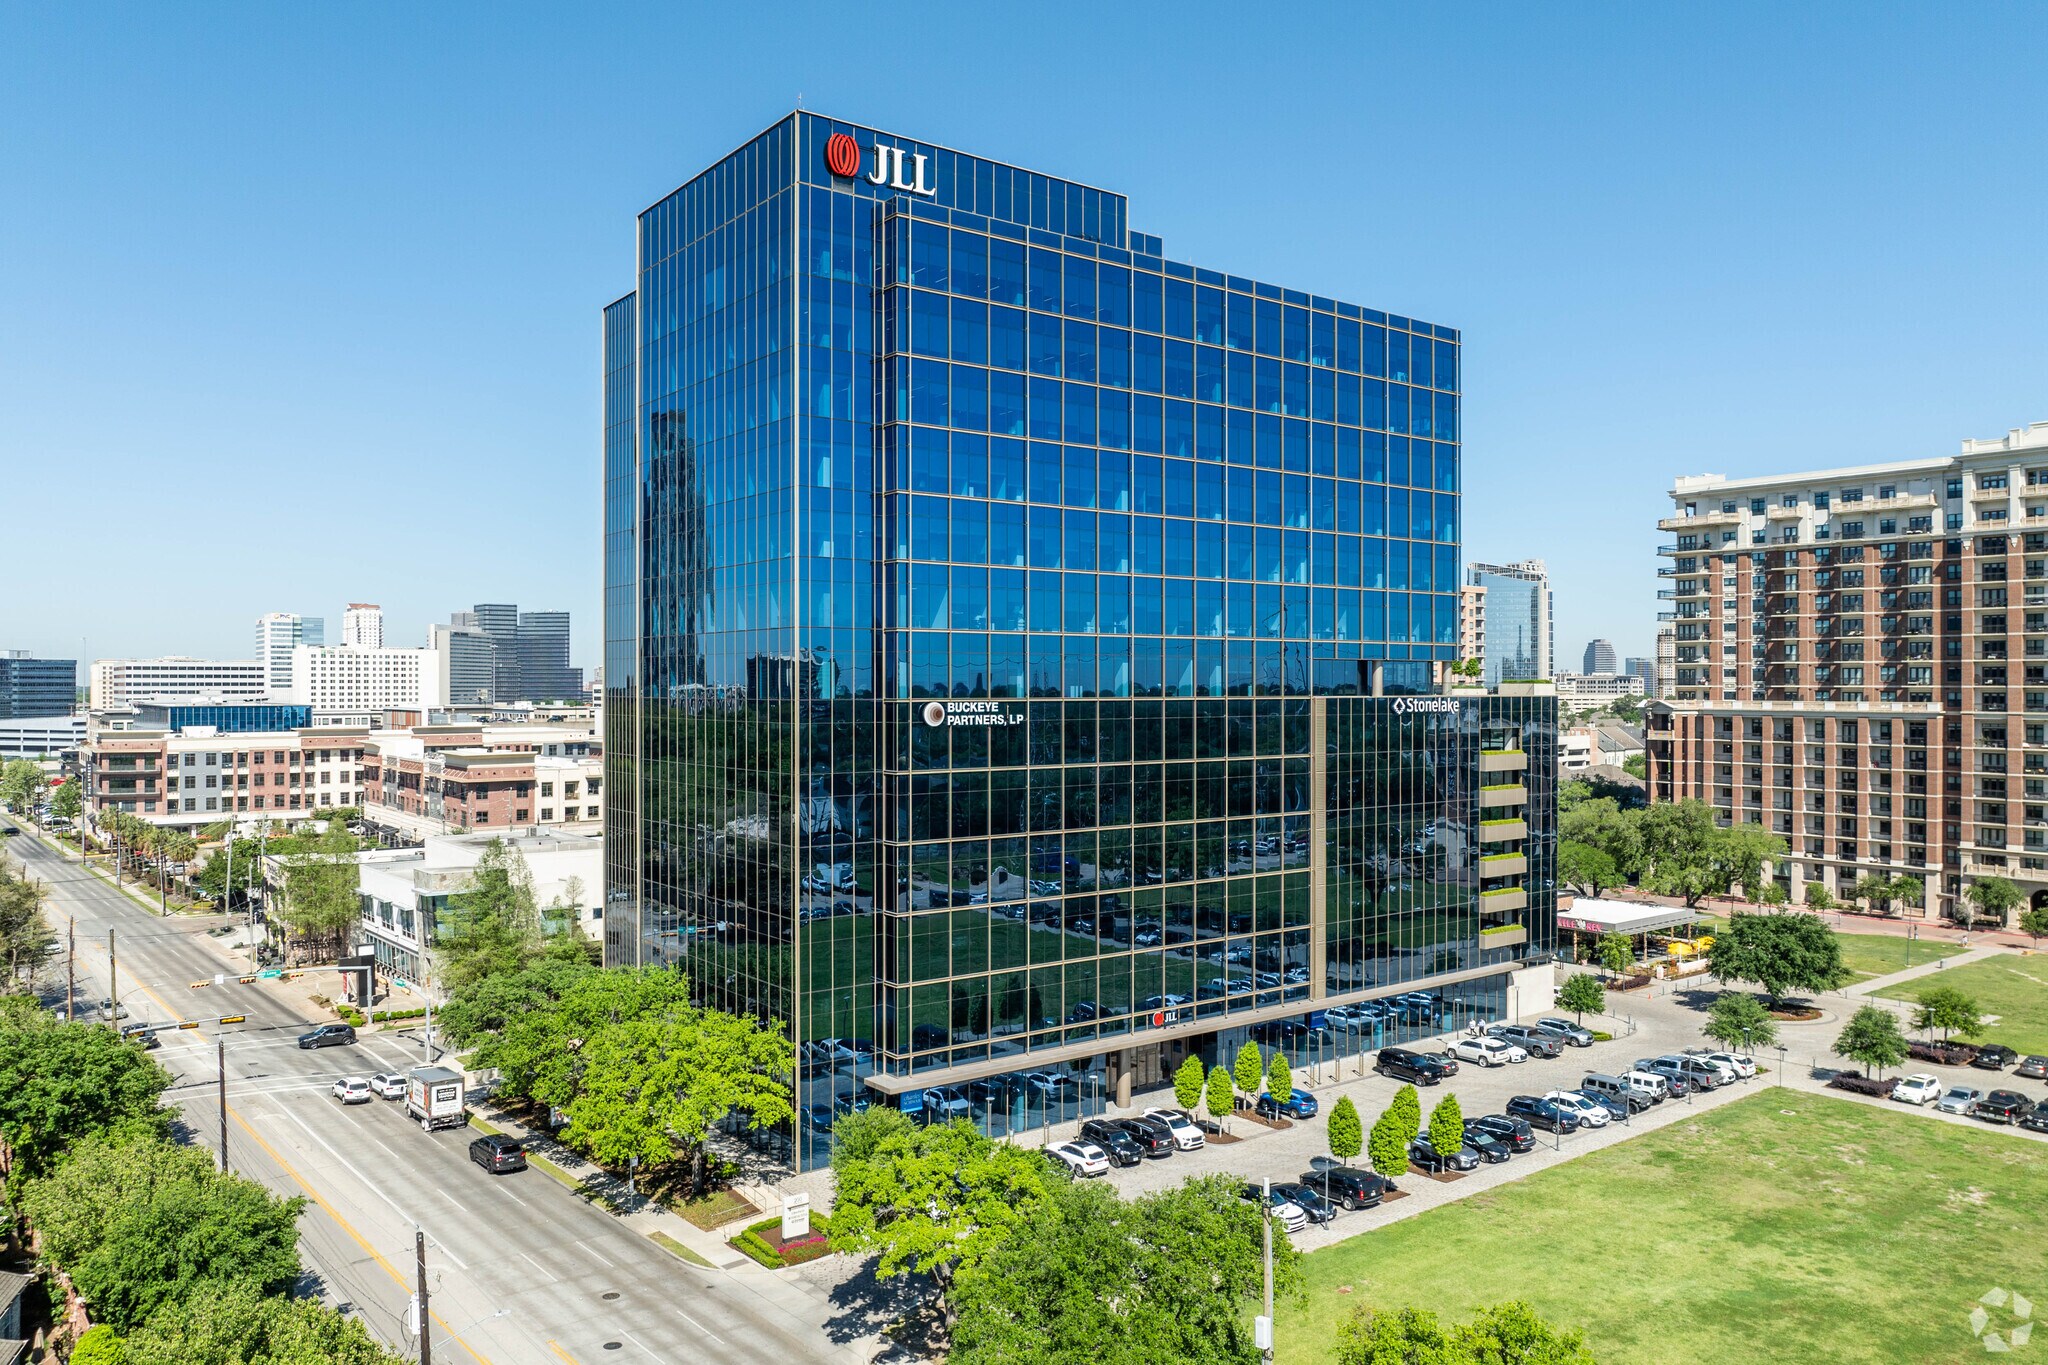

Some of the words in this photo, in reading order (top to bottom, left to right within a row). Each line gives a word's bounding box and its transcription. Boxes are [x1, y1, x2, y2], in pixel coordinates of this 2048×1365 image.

[868, 143, 936, 197] JLL
[947, 702, 999, 712] BUCKEYE
[1406, 697, 1460, 714] Stonelake
[947, 714, 1007, 726] PARTNERS,
[1009, 714, 1024, 725] LP
[1164, 1011, 1178, 1023] JLL
